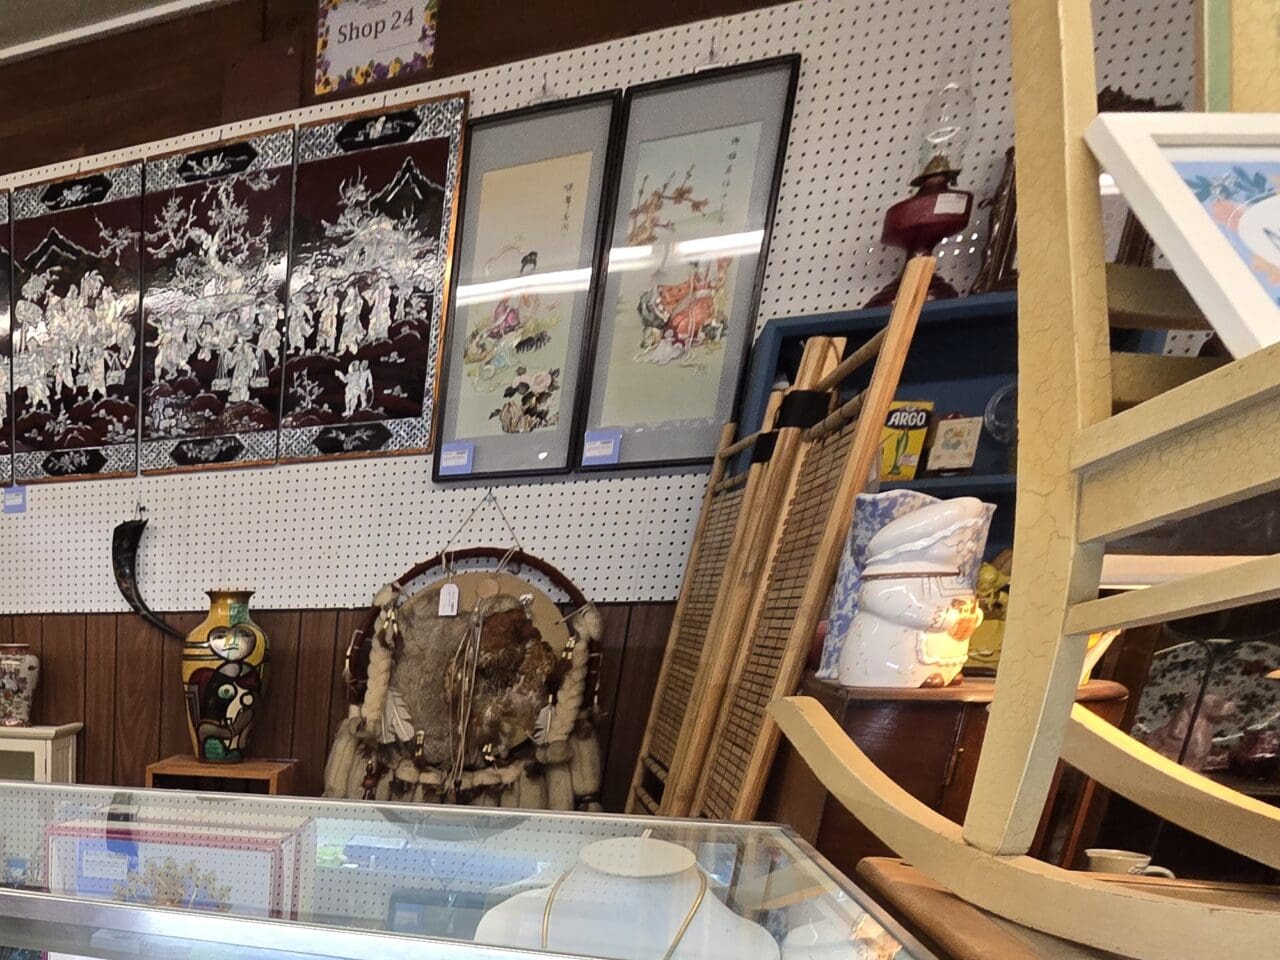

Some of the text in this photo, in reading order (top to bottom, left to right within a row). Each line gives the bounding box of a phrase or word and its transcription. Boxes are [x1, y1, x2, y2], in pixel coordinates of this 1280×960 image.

[337, 7, 414, 44] Shop 24
[887, 411, 927, 426] ARGO
